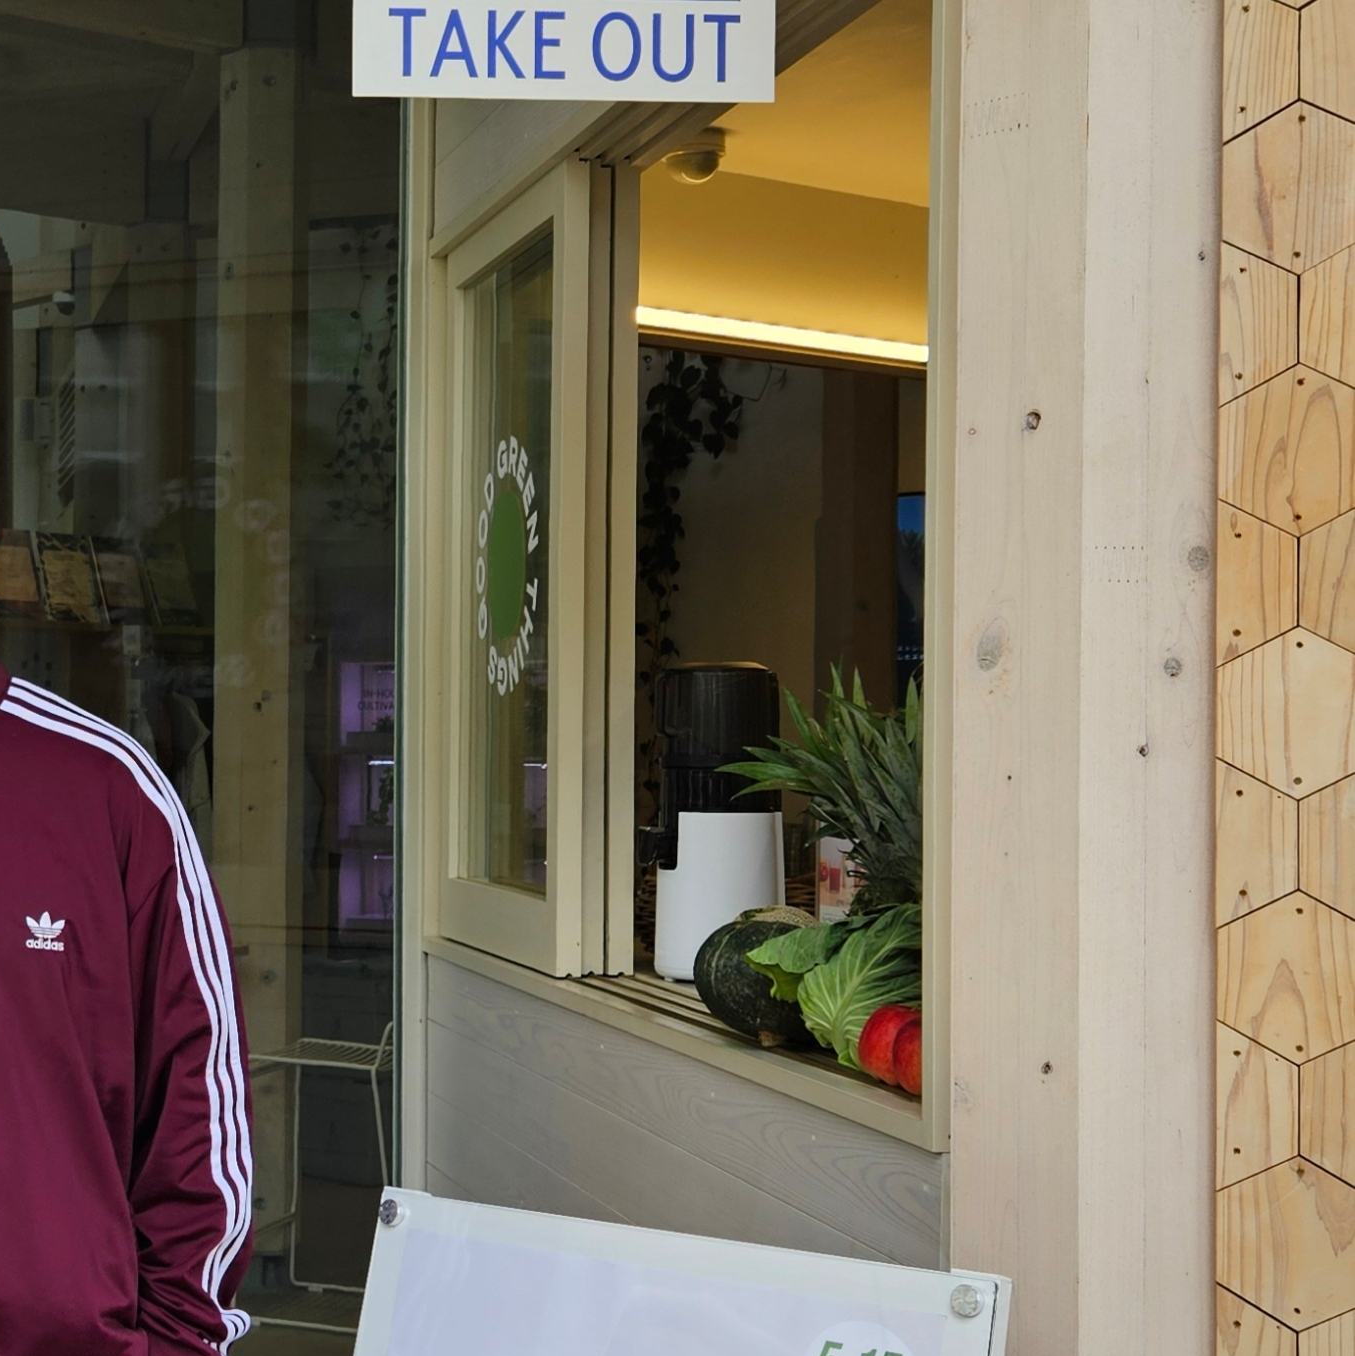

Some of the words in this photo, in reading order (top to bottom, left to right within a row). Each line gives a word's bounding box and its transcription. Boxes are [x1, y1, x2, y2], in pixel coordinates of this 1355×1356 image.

[389, 8, 566, 79] TAKE
[592, 11, 741, 83] OUT
[497, 436, 539, 555] GREEN
[476, 473, 494, 640] GOOD
[488, 578, 538, 696] THINGS
[26, 937, 65, 951] adidas
